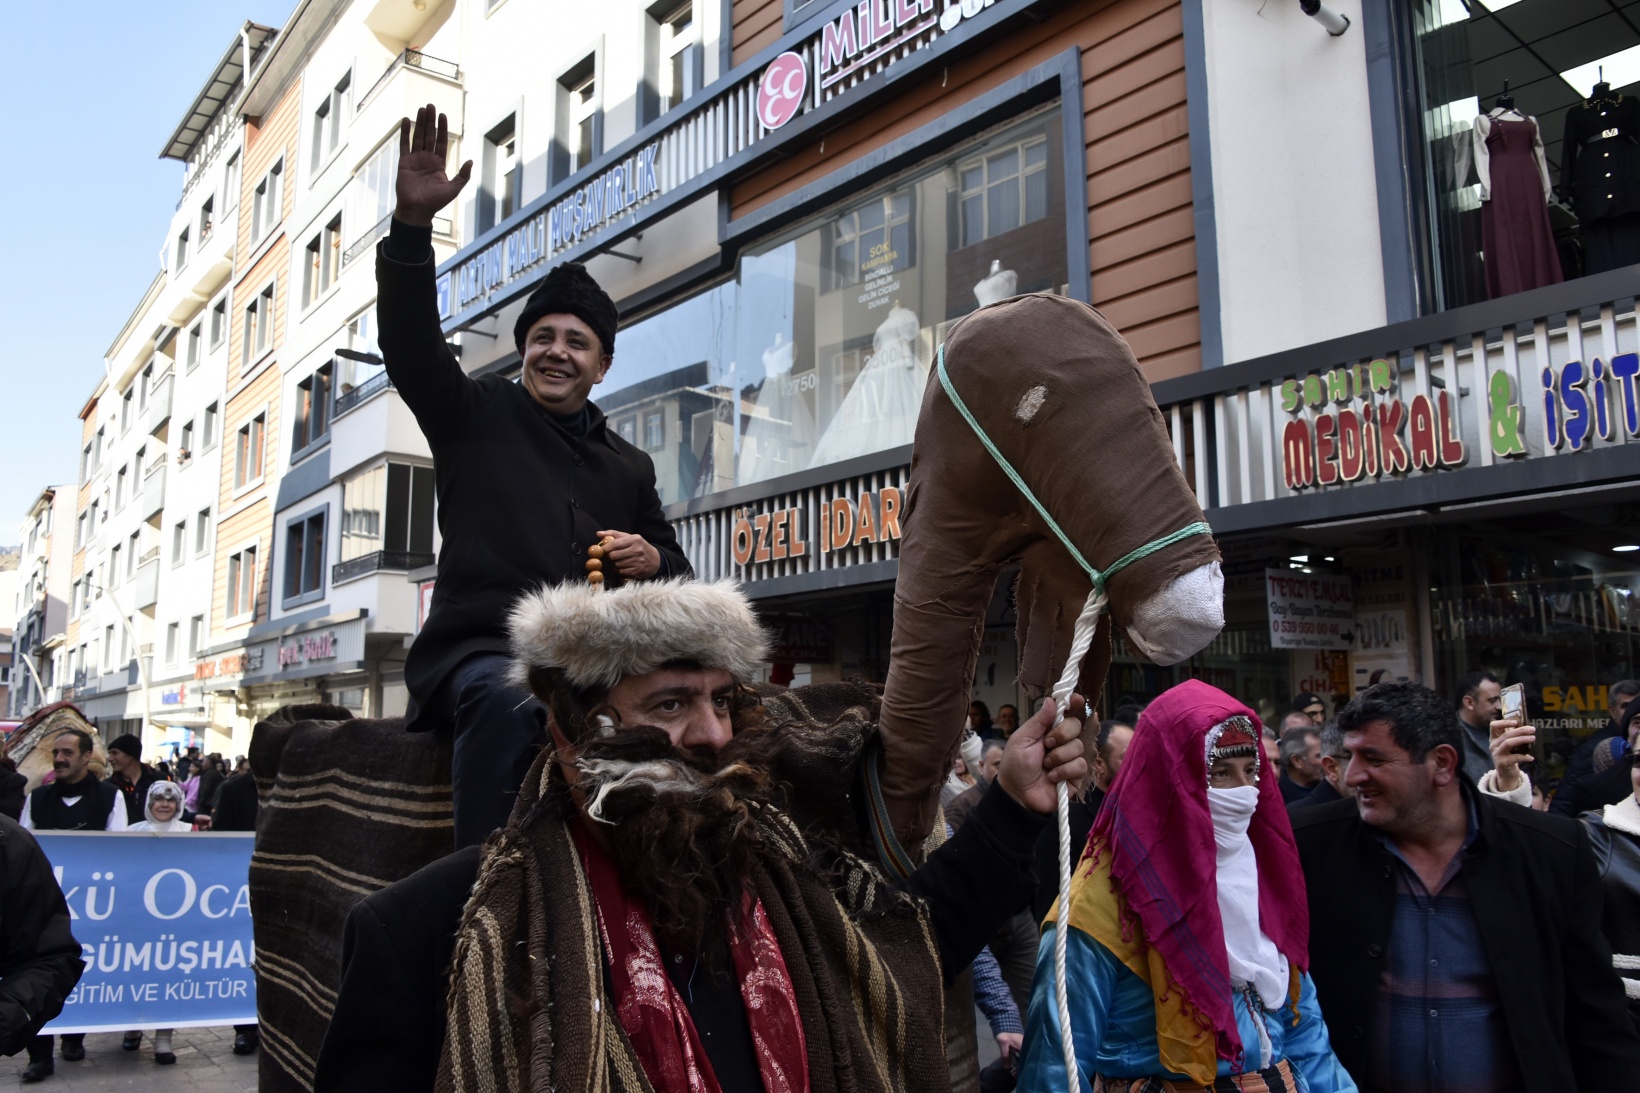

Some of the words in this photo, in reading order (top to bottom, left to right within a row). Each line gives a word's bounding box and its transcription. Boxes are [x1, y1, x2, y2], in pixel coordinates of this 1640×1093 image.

[821, 0, 933, 74] MİLL
[459, 242, 503, 306] ARTUN
[507, 214, 545, 277] MALİ
[551, 143, 659, 250] MÜŞAVİRLİK
[858, 290, 877, 303] GELİN
[868, 296, 890, 309] DUVAK
[1281, 359, 1391, 411] SAHİR
[1282, 390, 1465, 489] MEDİKAL
[1488, 369, 1526, 457] &
[733, 507, 805, 566] ÖZEL
[821, 483, 908, 553] İDAR
[1273, 620, 1280, 632] 0
[1281, 621, 1298, 633] 539
[1542, 685, 1610, 711] SAH
[82, 934, 255, 974] GÜMÜŞHA
[130, 983, 159, 1001] VE
[165, 978, 247, 1000] KÜLTÜR
